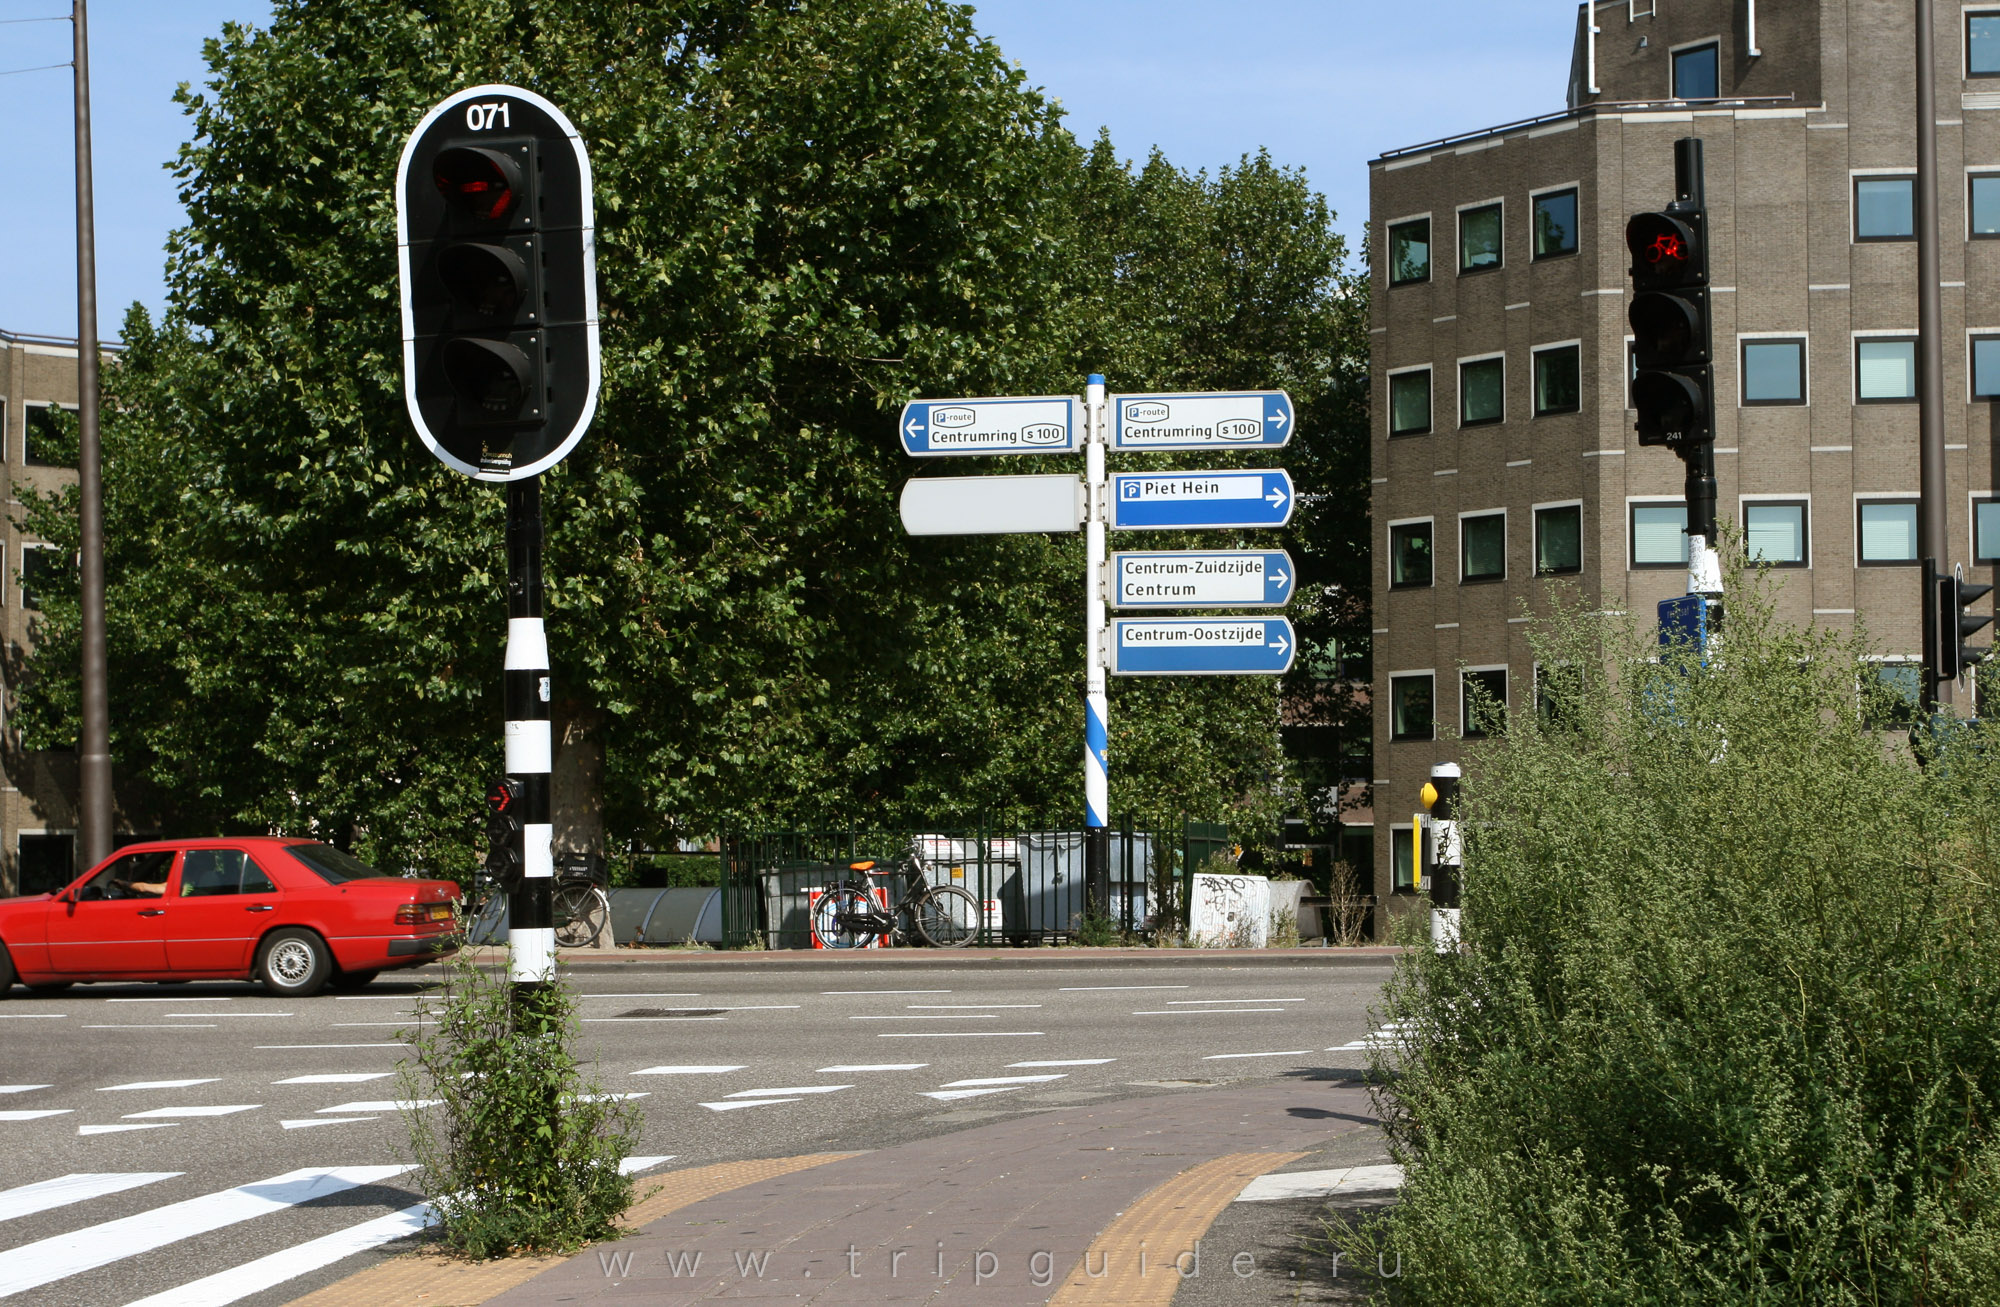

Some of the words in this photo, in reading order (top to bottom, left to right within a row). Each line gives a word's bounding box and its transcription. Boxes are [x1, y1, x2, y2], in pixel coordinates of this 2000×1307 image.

[466, 102, 510, 131] 071
[932, 430, 1017, 444] Centrumring
[1038, 428, 1060, 439] 100
[1124, 425, 1212, 439] Centrumring
[1233, 424, 1256, 435] 100
[1666, 432, 1682, 440] 241
[1145, 482, 1176, 495] Piet
[1183, 481, 1219, 494] Hein
[1125, 560, 1262, 576] Centrum-Zuidzijde
[1125, 583, 1196, 596] Centrum
[1125, 627, 1263, 643] Centrum-Oostzijde
